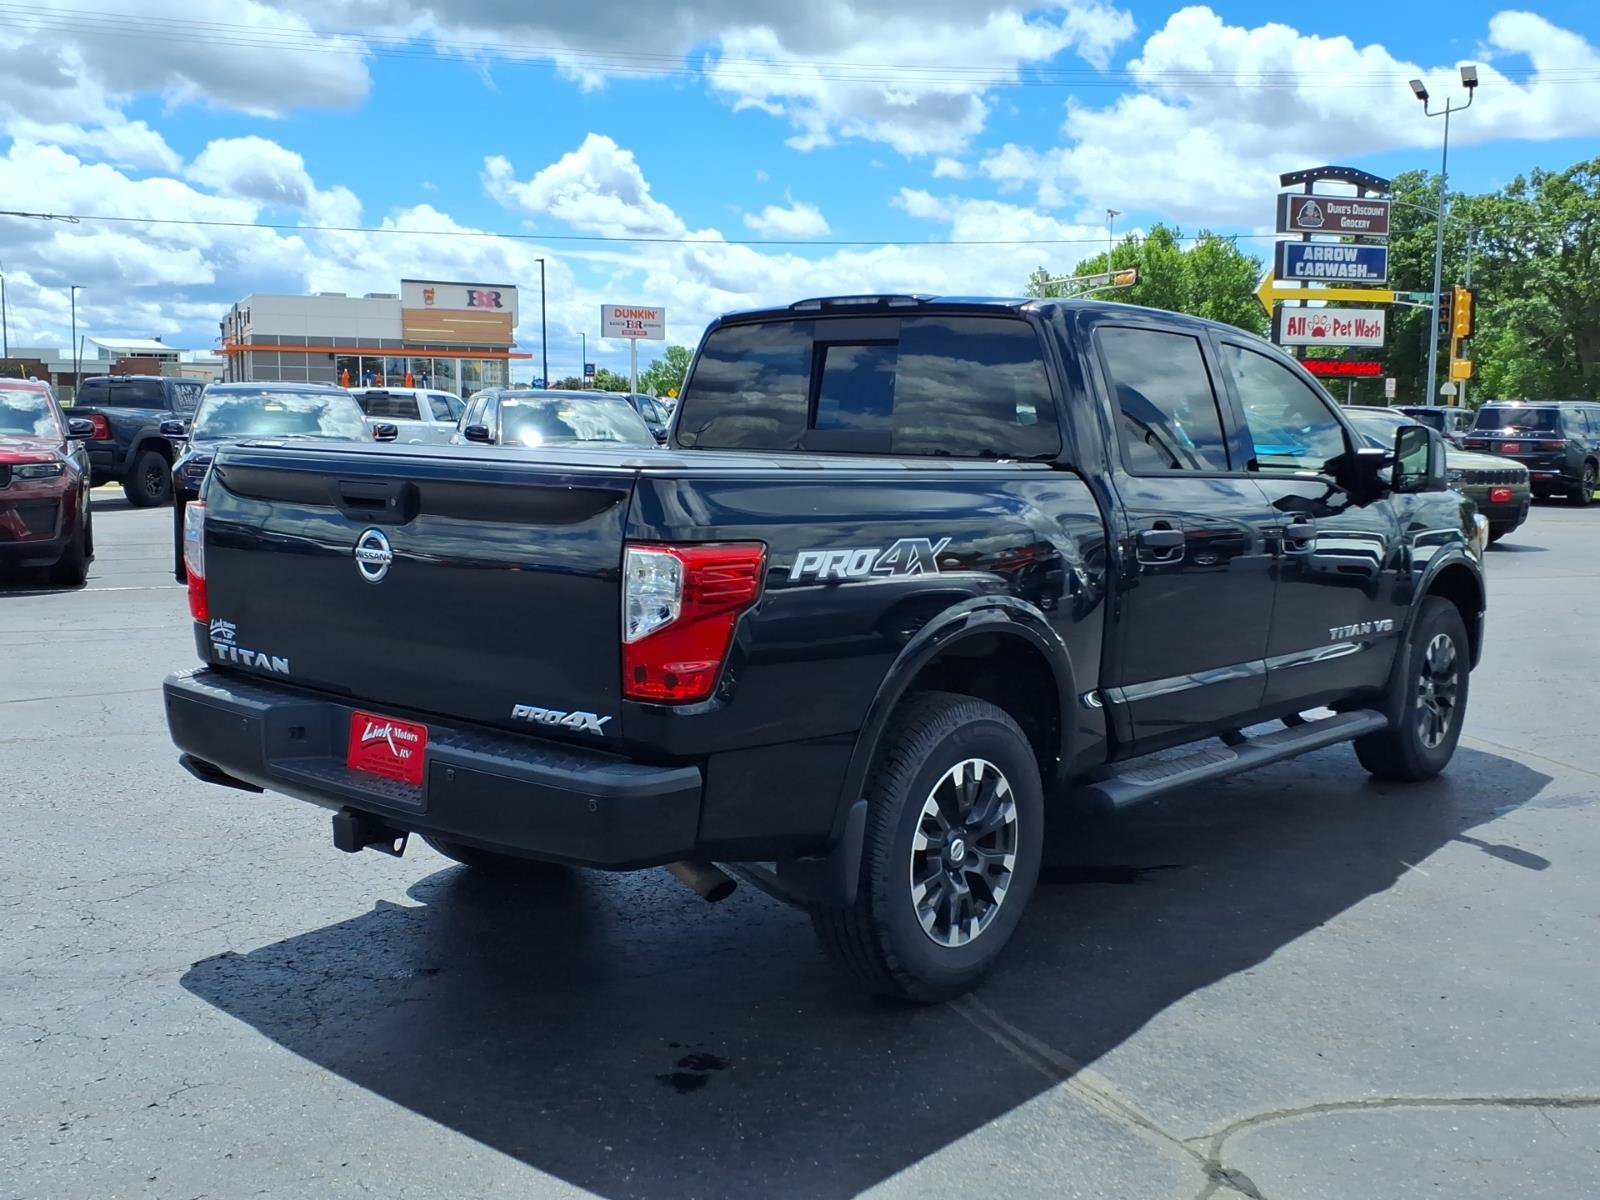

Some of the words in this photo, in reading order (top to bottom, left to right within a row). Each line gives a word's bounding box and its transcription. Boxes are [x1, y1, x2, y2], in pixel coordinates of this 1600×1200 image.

[1353, 204, 1385, 216] DISCOUNT
[1341, 217, 1370, 228] GROCERY
[1303, 247, 1358, 262] ARROW
[1287, 317, 1306, 336] All
[1332, 318, 1352, 336] Pet
[1355, 319, 1381, 338] Wash
[357, 550, 386, 561] NISSAN
[1329, 622, 1372, 641] TITAN
[213, 642, 290, 675] TITAN
[362, 721, 399, 757] Link
[393, 728, 419, 743] Motors
[399, 748, 413, 759] RV
